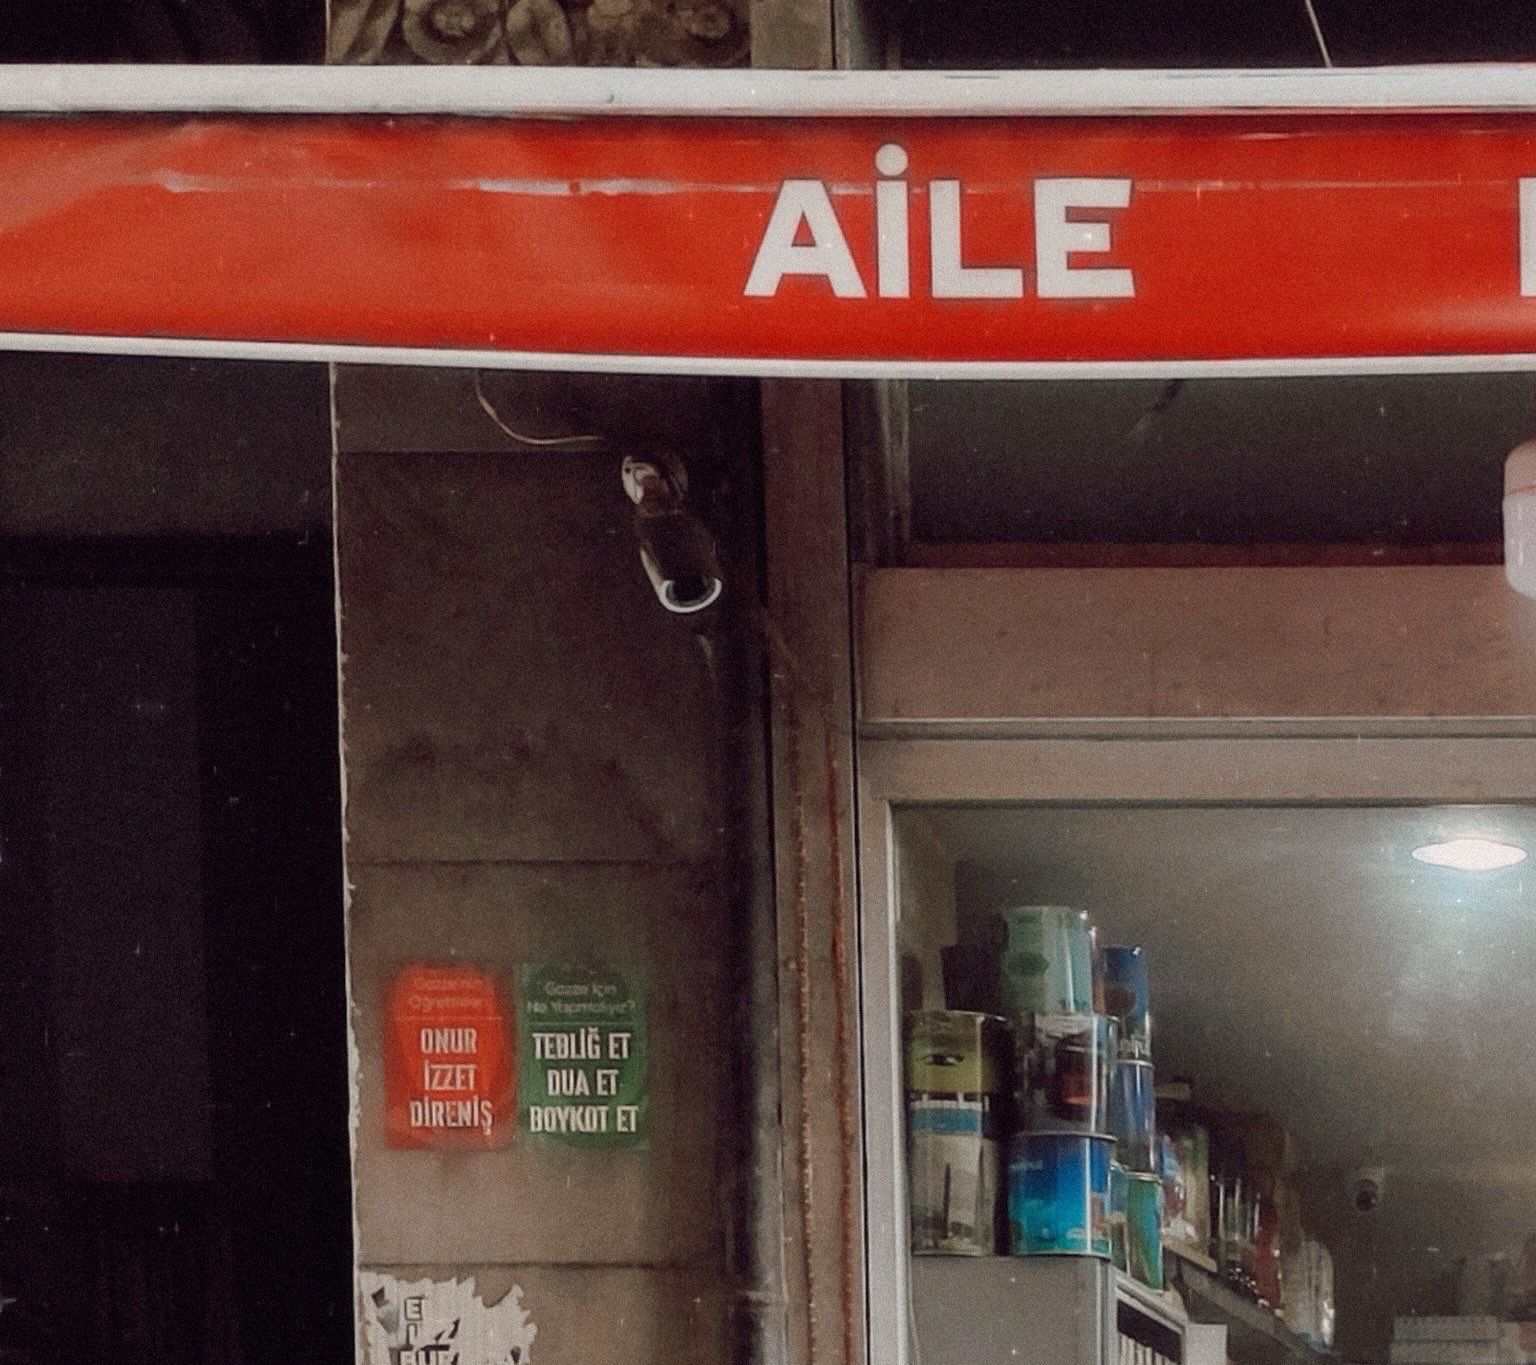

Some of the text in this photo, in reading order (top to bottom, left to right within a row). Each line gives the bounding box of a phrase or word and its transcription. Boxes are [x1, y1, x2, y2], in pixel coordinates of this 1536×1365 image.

[743, 142, 1135, 299] AİLE
[420, 1027, 478, 1054] ONUR
[532, 1027, 632, 1060] TEBLİĞ ET
[424, 1059, 478, 1091] İZZET
[547, 1069, 619, 1096] DUA ET
[409, 1096, 494, 1135] DİRENİŞ
[530, 1105, 639, 1133] BOYKOT ET
